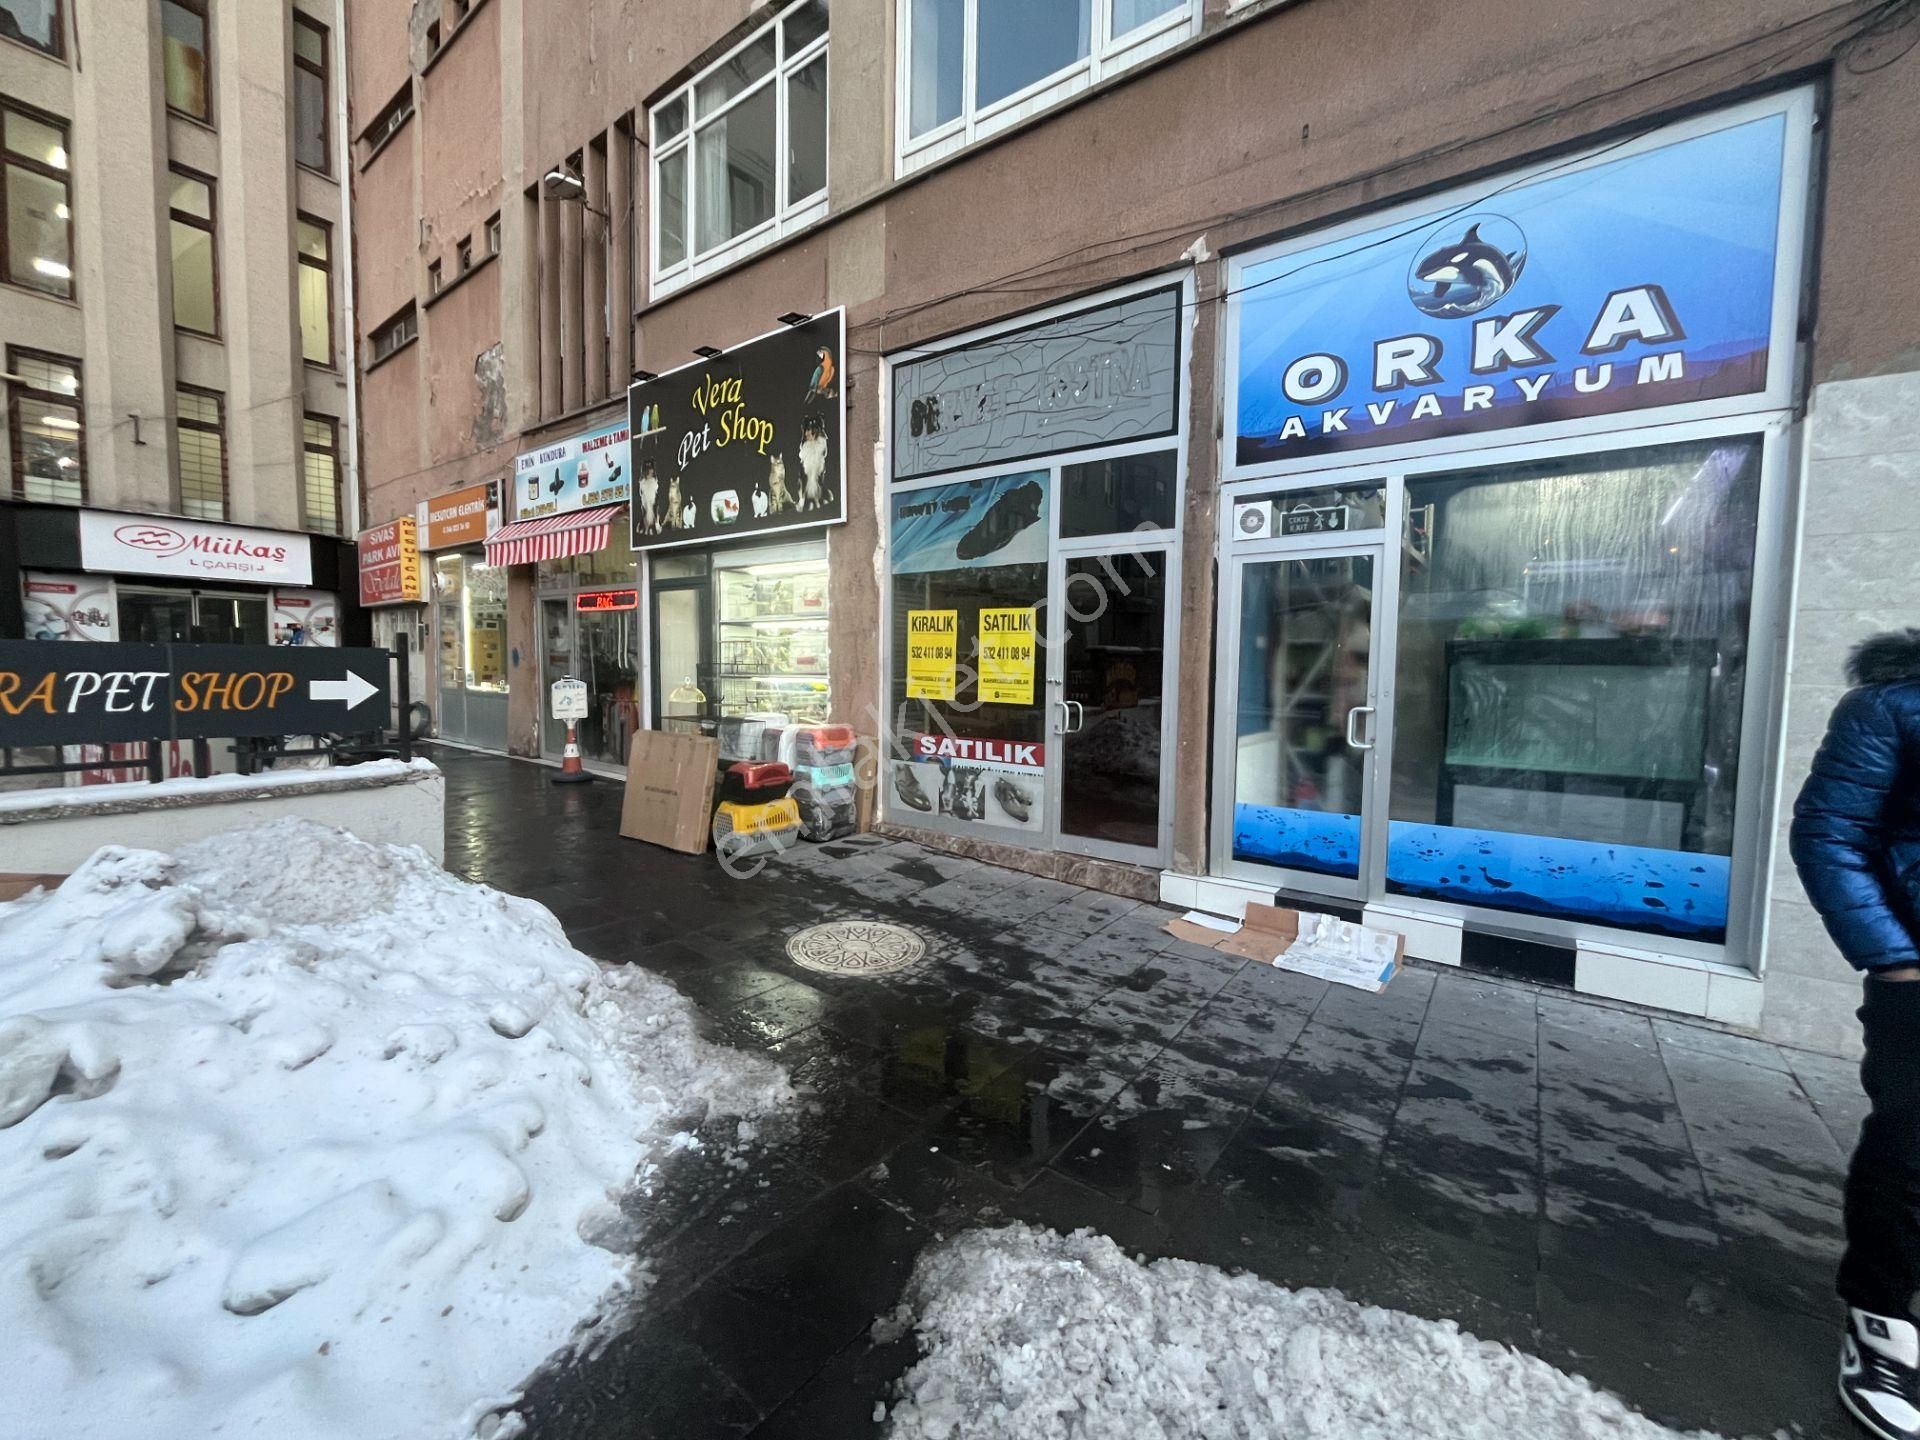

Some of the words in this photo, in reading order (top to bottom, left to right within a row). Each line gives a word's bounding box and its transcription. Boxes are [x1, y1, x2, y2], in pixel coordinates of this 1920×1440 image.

[1281, 284, 1686, 405] ORKA
[692, 373, 744, 416] Vera
[1279, 351, 1684, 440] AKVARYUM
[678, 422, 711, 471] Pet
[716, 402, 774, 455] Shop
[363, 545, 384, 564] PARK
[983, 613, 1031, 632] SATILIK
[911, 646, 922, 659] 532
[923, 646, 934, 659] 411
[996, 646, 1009, 660] 411
[174, 671, 294, 712] SHOP
[920, 736, 1037, 766] SATILIK
